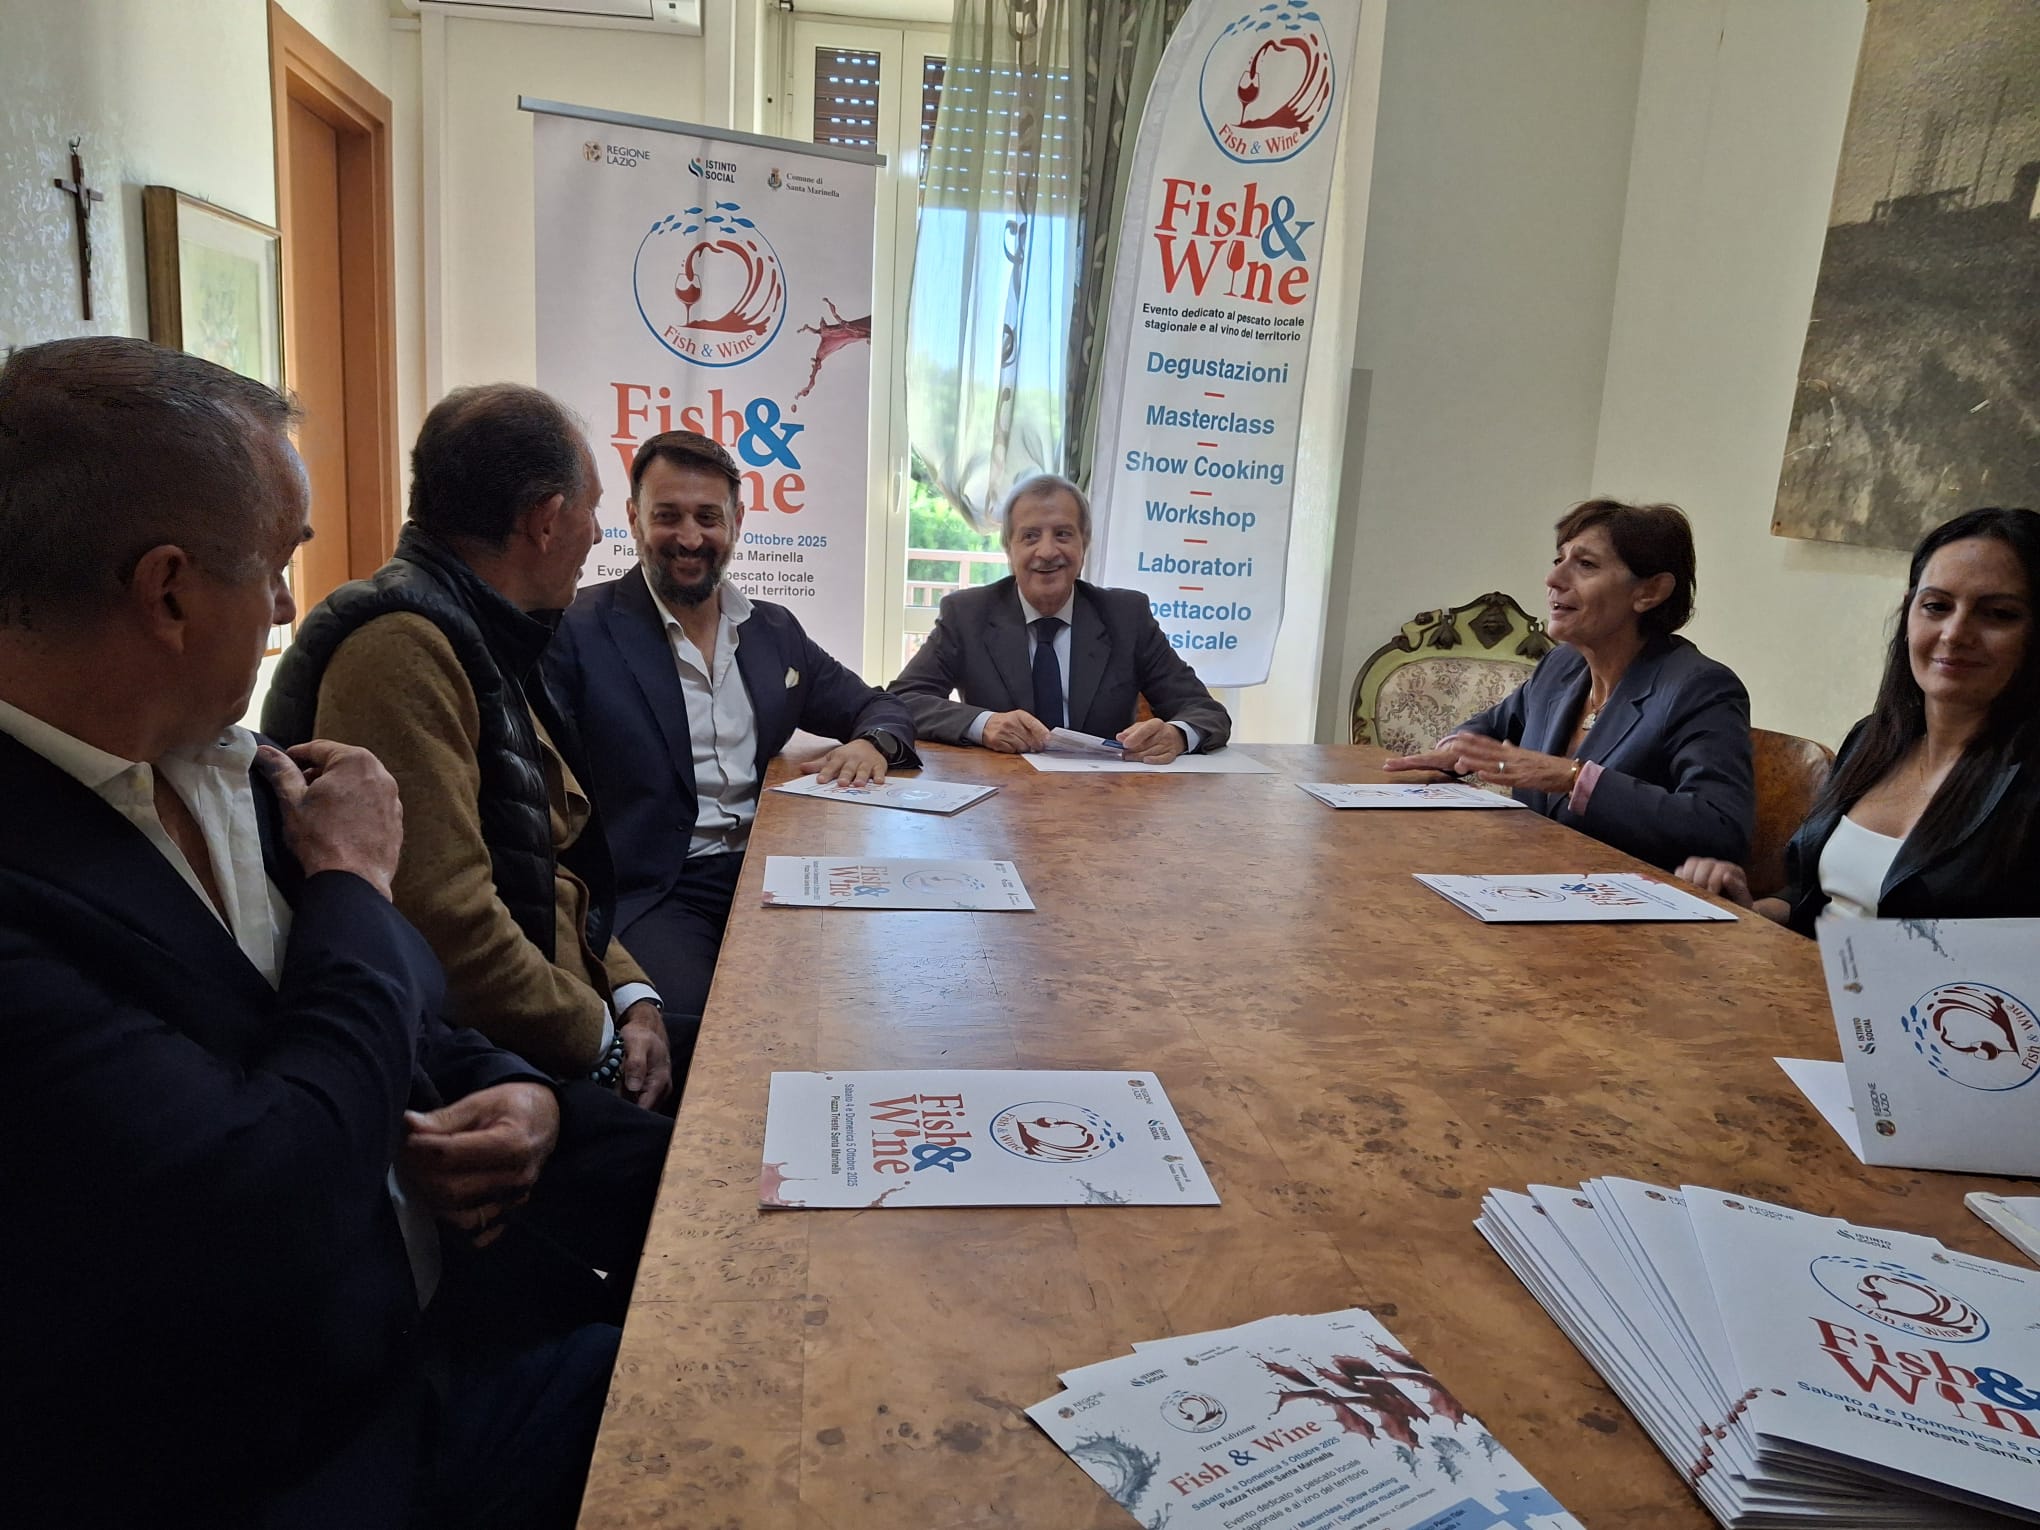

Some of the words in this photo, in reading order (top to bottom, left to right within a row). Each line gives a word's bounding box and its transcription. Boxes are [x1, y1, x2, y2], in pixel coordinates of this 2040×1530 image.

[1219, 123, 1247, 155] Fish
[1250, 141, 1261, 154] &
[1265, 131, 1298, 154] Wine
[606, 145, 651, 160] REGIONE
[606, 155, 638, 168] LAZIO
[705, 159, 738, 174] ISTINTO
[705, 171, 736, 184] SOCIAL
[786, 172, 813, 185] Comune
[815, 176, 824, 185] di
[785, 182, 806, 193] Santa
[806, 185, 841, 199] Marinella
[1142, 303, 1179, 317] Evento
[1181, 307, 1225, 319] dedicato
[1227, 310, 1236, 321] al
[1237, 313, 1271, 327] pescato
[1274, 316, 1305, 327] locale
[664, 325, 697, 356] Fish
[701, 344, 713, 358] &
[716, 334, 757, 358] Wine
[1144, 319, 1198, 333] stagionale
[1199, 323, 1207, 332] e
[1209, 323, 1219, 333] al
[1221, 325, 1240, 337] vino
[1241, 328, 1254, 339] del
[1255, 330, 1301, 342] territorio
[1147, 352, 1289, 384] Degustazioni
[1146, 405, 1275, 435] Masterclass
[1125, 451, 1188, 475] Show
[1194, 456, 1285, 486] Cooking
[1145, 500, 1256, 533] Workshop
[600, 527, 628, 539] ato
[744, 532, 794, 546] Ottobre
[797, 535, 828, 548] 2025
[748, 550, 804, 563] Marinella
[1138, 552, 1253, 578] Laboratori
[778, 571, 815, 583] locale
[740, 584, 759, 596] del
[762, 585, 816, 597] territorio
[1166, 630, 1238, 650] sicale
[1863, 1018, 1875, 1041] SOCIAL
[2005, 1004, 2034, 1031] Wine
[2021, 1046, 2040, 1070] Fish
[845, 1083, 854, 1102] Sabato
[1867, 1082, 1882, 1117] REGIONE
[1879, 1093, 1892, 1117] LAZIO
[831, 1113, 840, 1131] Trieste
[846, 1113, 856, 1142] Domenica
[831, 1132, 841, 1148] Santa
[831, 1149, 841, 1175] Marinella
[846, 1147, 857, 1171] Ottobre
[847, 1172, 858, 1187] 2025
[1797, 1381, 1863, 1408] Sabato
[1868, 1402, 1878, 1411] 4
[1886, 1407, 1896, 1416] e
[1902, 1411, 2002, 1446] Domenica
[2007, 1440, 2020, 1451] 5
[1221, 1424, 1256, 1442] Edizione
[1843, 1405, 1903, 1428] Piazza
[1904, 1422, 1970, 1447] Trieste
[1974, 1441, 2033, 1465] Santa
[1168, 1462, 1231, 1497] Fish
[1228, 1449, 1259, 1467] &
[1251, 1419, 1322, 1453] Wine
[1191, 1491, 1225, 1511] Sabato
[1238, 1463, 1282, 1487] Domenica
[1281, 1459, 1290, 1467] 5
[1288, 1445, 1320, 1463] Ottobre
[1319, 1437, 1341, 1450] 2025
[1219, 1493, 1248, 1510] Piazza
[1245, 1479, 1275, 1496] Trieste
[1277, 1467, 1299, 1483] Santa
[1299, 1451, 1334, 1470] Marinella
[1223, 1510, 1257, 1530] Evento
[1257, 1491, 1294, 1512] dedicato
[1304, 1469, 1337, 1490] pescato
